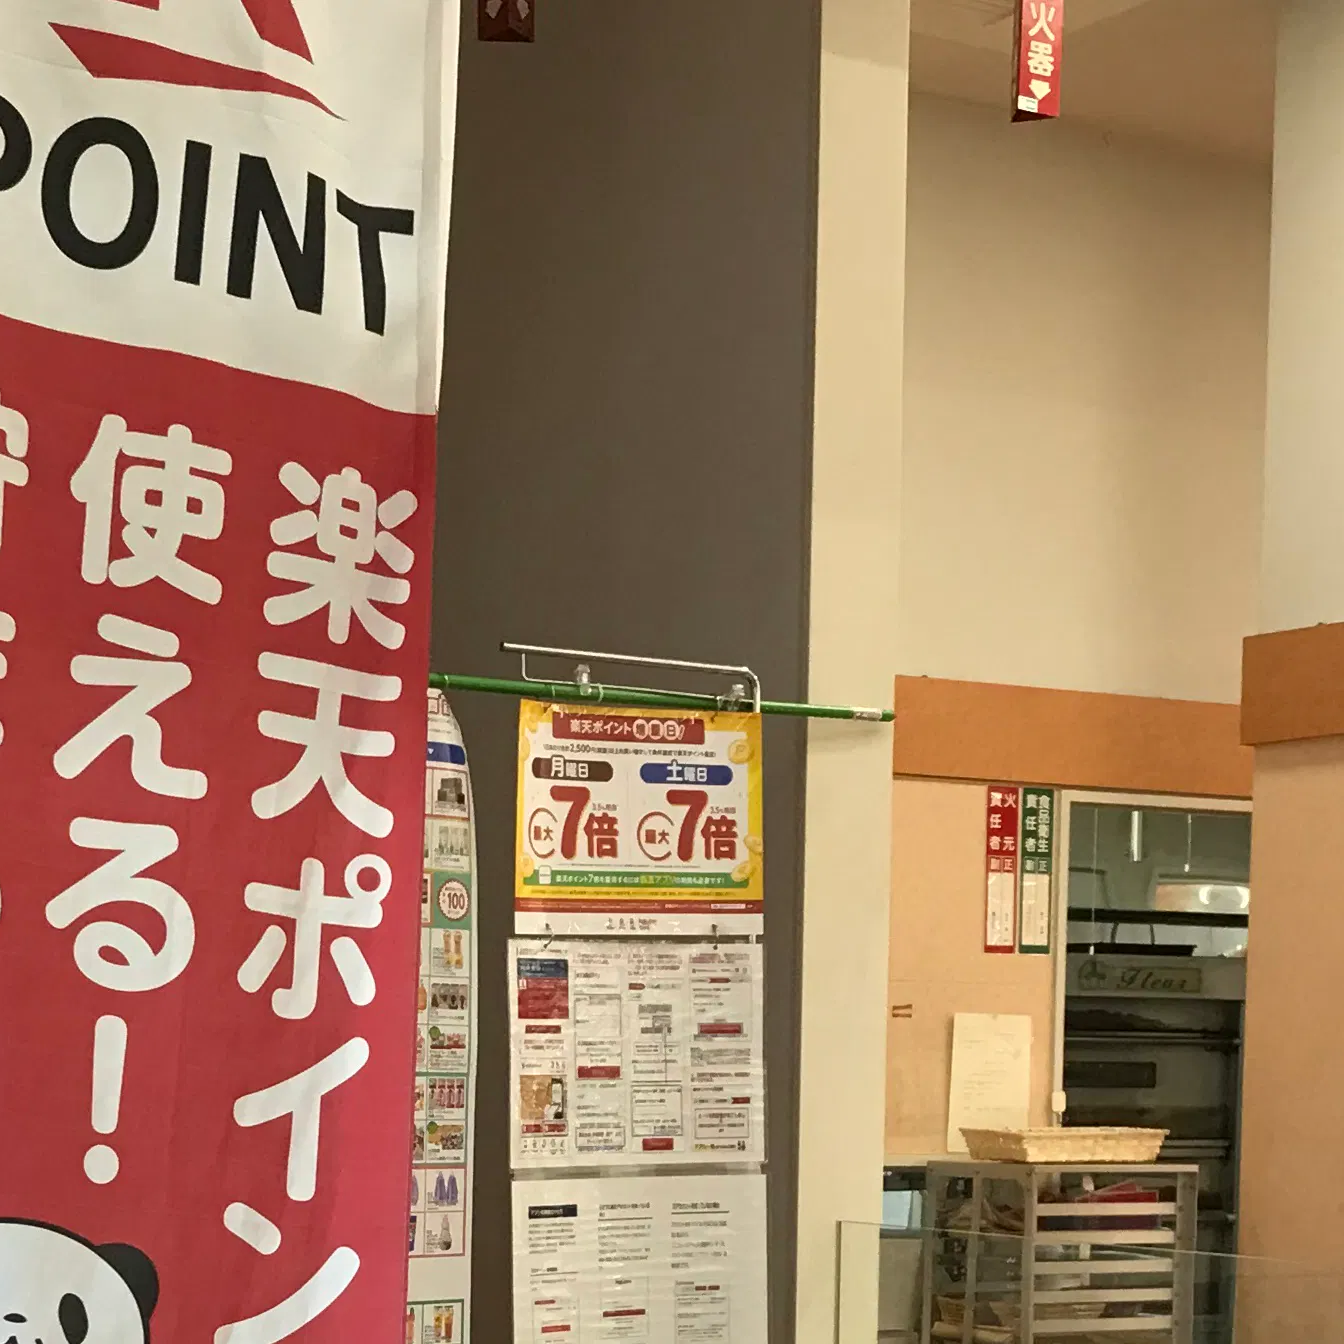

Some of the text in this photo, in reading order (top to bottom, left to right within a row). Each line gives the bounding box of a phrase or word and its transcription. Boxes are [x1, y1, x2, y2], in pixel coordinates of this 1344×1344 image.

[551, 756, 588, 778] 月曜日
[667, 761, 707, 782] 土曜日
[44, 413, 233, 1184] 使える!
[534, 825, 553, 841] 最大
[645, 829, 669, 845] 最大
